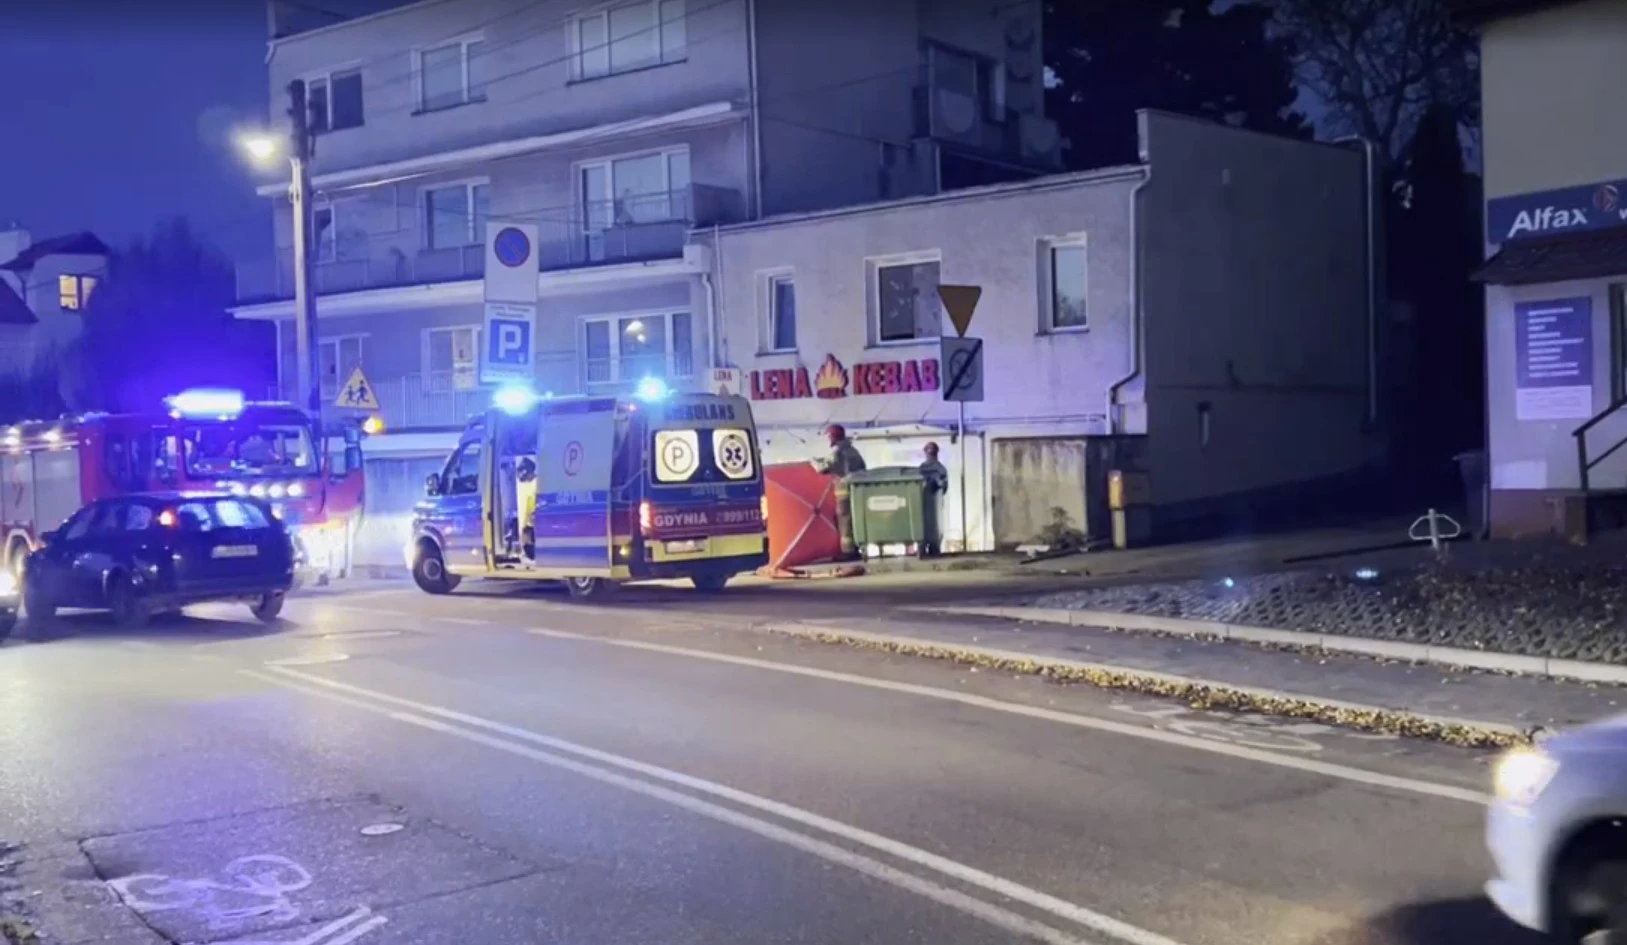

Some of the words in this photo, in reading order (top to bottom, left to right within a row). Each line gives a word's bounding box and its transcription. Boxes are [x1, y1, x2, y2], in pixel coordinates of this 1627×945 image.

[1507, 206, 1588, 239] Alfax
[499, 324, 522, 359] P
[714, 370, 732, 381] LENA
[751, 367, 812, 400] LENA
[853, 359, 940, 395] KEBAB
[653, 511, 708, 527] GDYNIA
